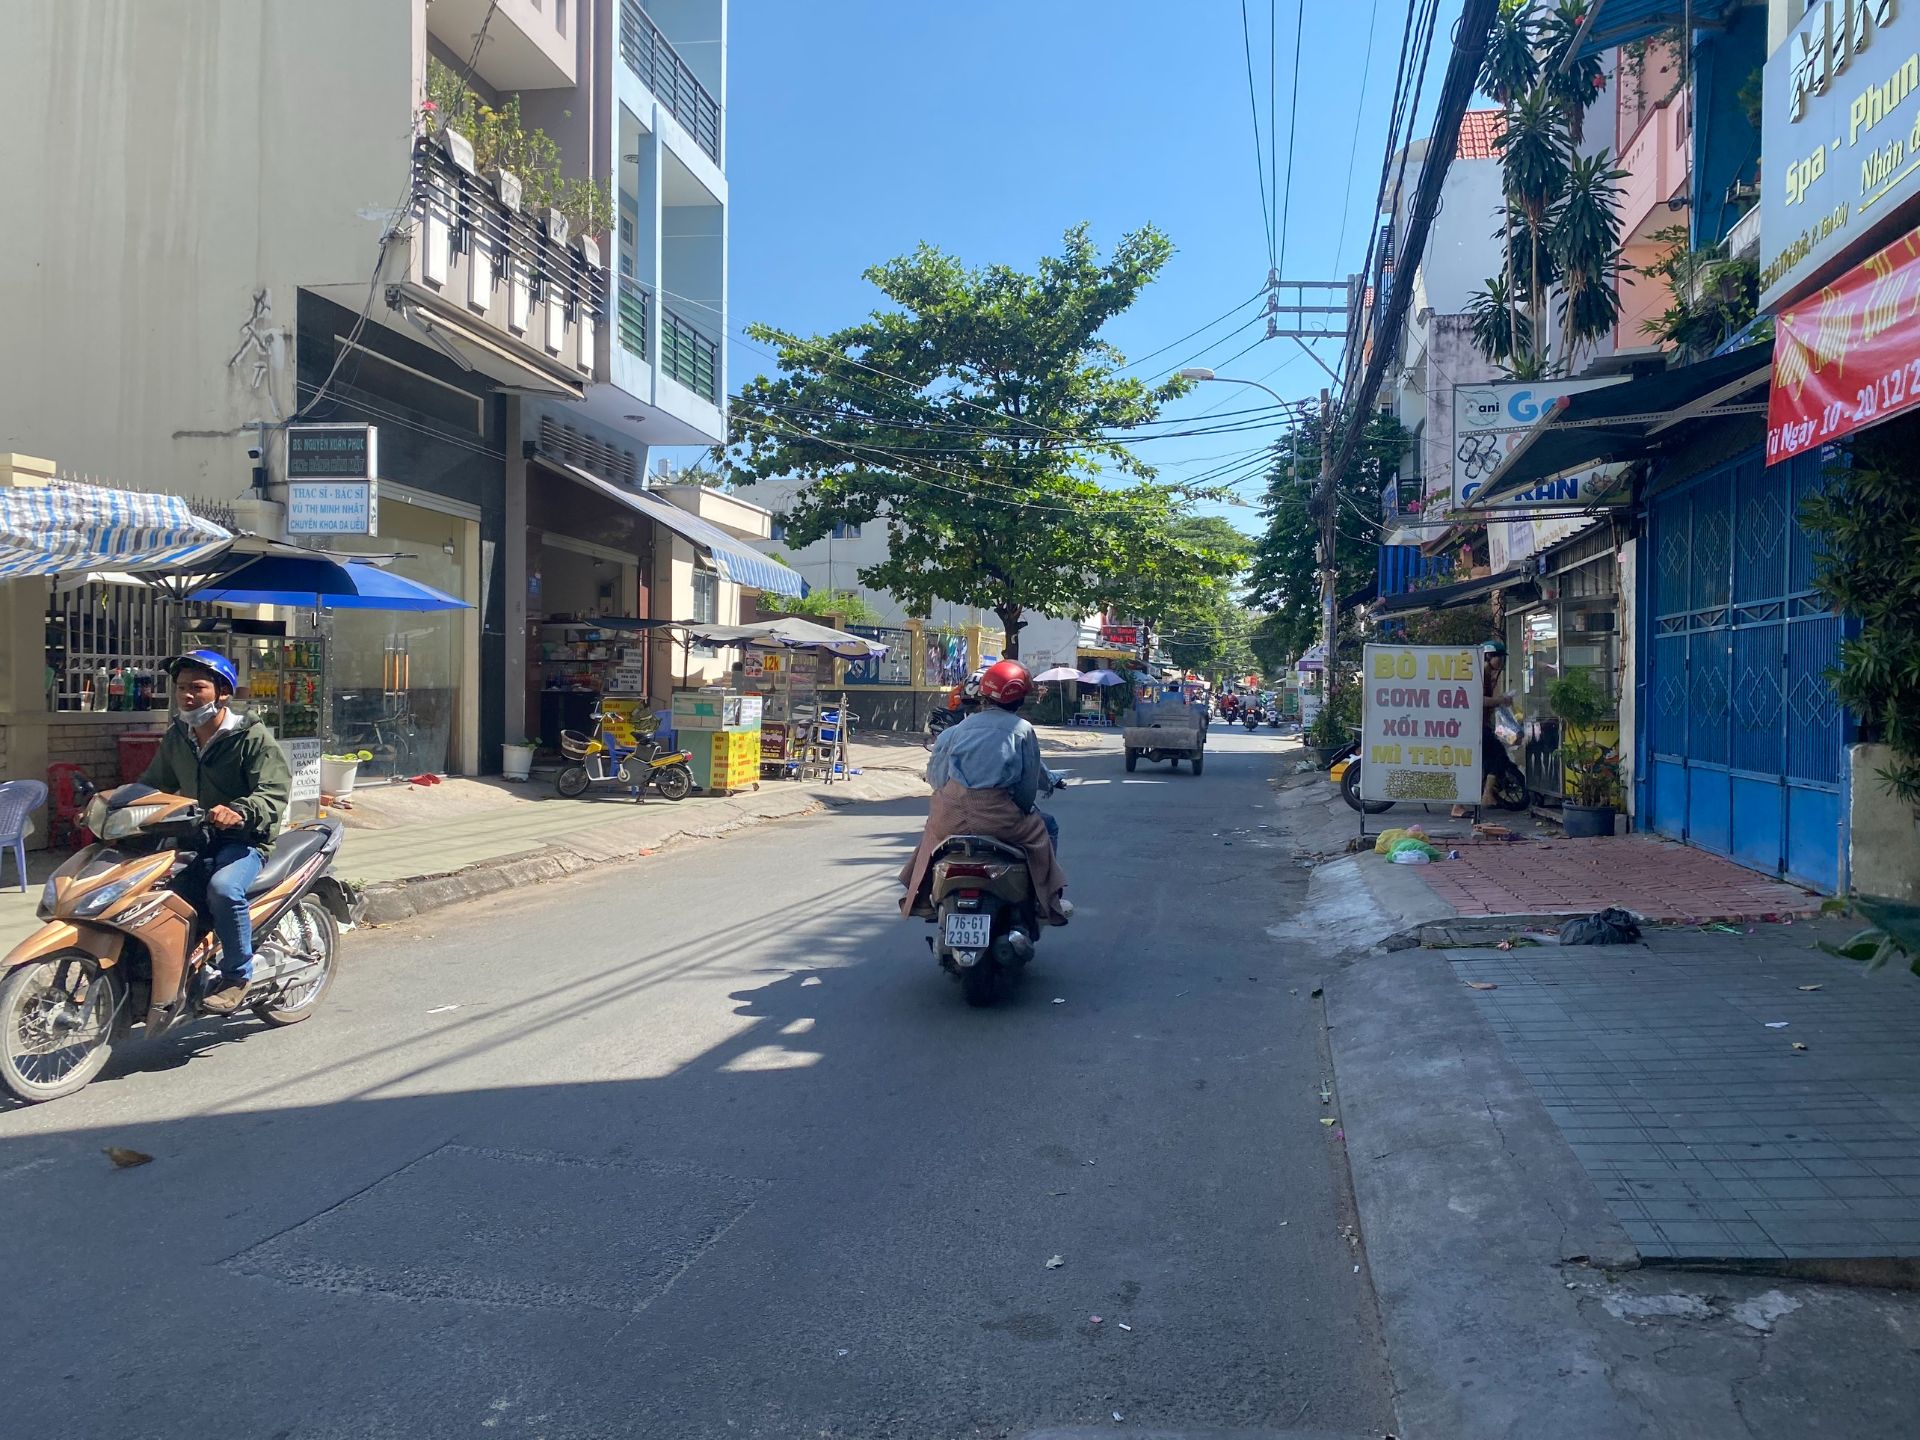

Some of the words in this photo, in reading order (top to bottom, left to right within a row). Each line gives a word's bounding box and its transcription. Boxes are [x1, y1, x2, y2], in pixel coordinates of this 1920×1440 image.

[1785, 144, 1826, 207] Spa
[1850, 52, 1919, 148] Phun
[1861, 138, 1905, 198] Nhận
[1781, 415, 1817, 453] Ngày
[1820, 401, 1841, 436] 10
[293, 487, 317, 499] THẠC
[335, 486, 353, 499] BÁC
[305, 504, 318, 515] THỊ
[320, 504, 340, 514] MINH
[290, 518, 318, 530] CHUYÊN
[319, 519, 338, 530] KHOA
[764, 655, 779, 671] 12k
[1374, 651, 1417, 680] BÒ
[1376, 687, 1430, 708] CƠM
[1437, 685, 1470, 709] GÀ
[1382, 714, 1419, 737] XỐI
[1371, 743, 1401, 764] MÌ
[1408, 745, 1473, 770] TRỘN
[954, 917, 983, 929] 76-G1
[949, 931, 986, 944] 239.51
